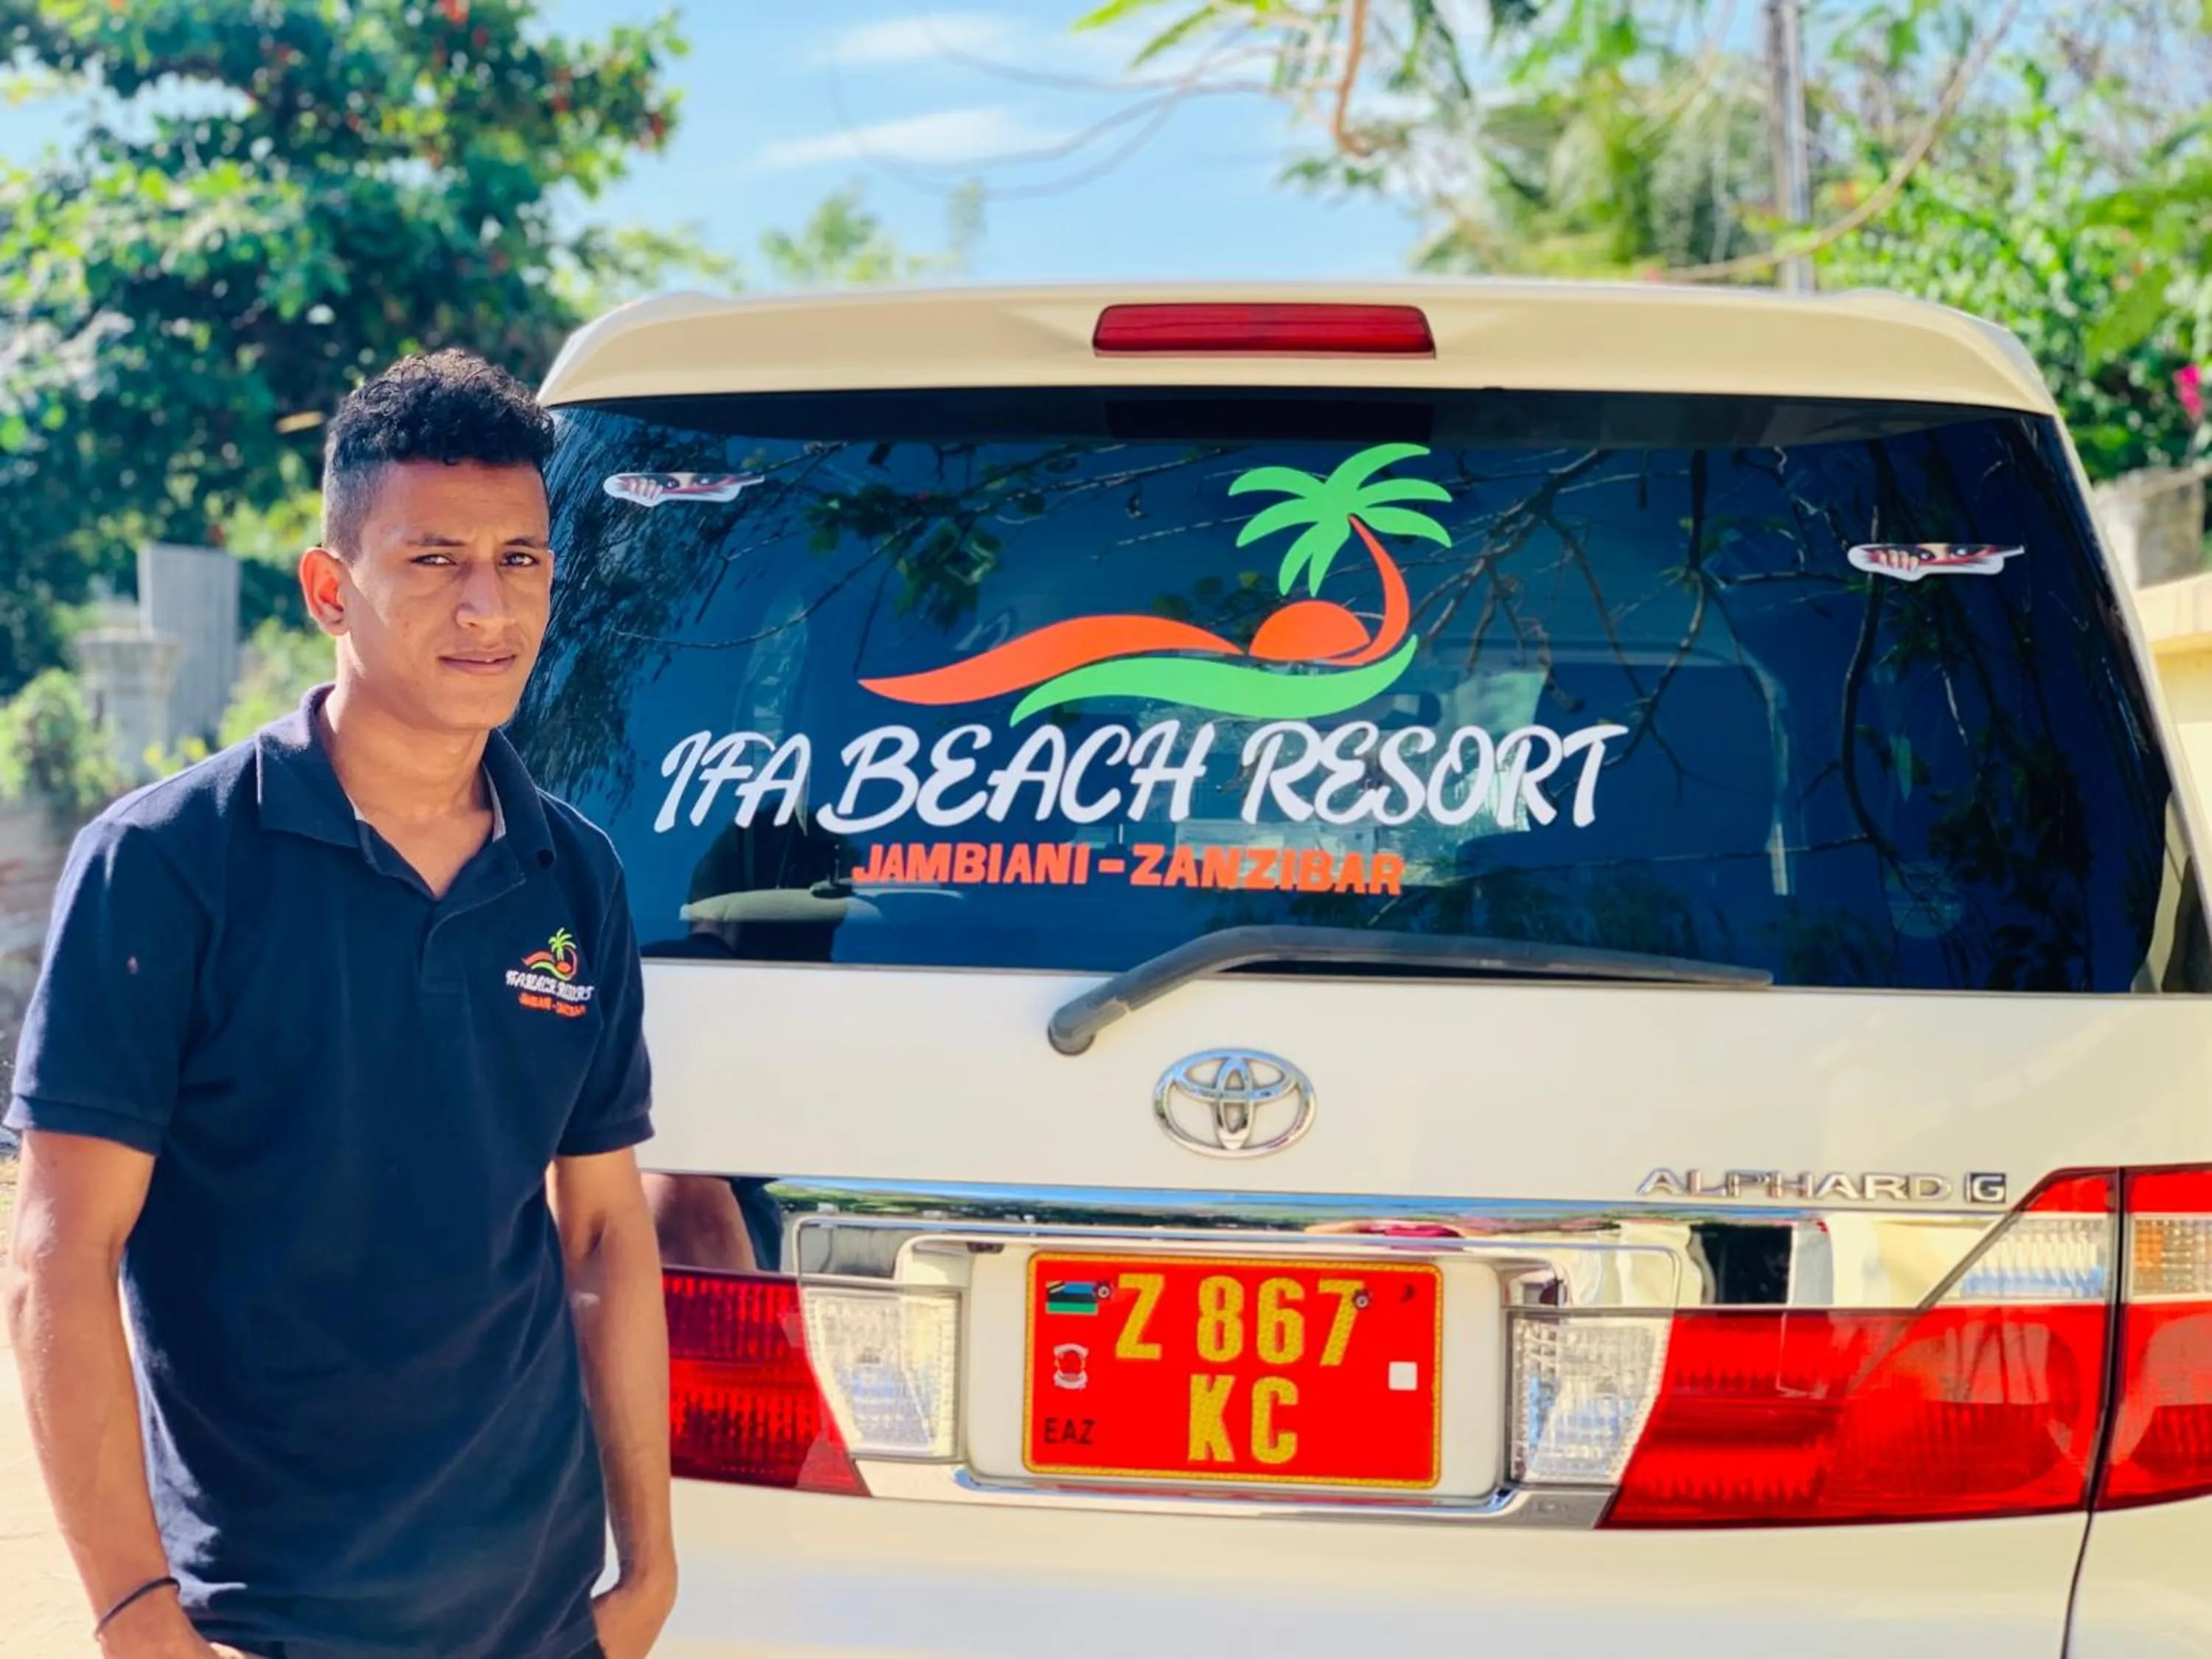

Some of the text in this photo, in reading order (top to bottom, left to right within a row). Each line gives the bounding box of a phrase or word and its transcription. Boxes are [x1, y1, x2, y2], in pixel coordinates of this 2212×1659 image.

[653, 720, 1629, 833] IFA BEACH RESORT
[1635, 1168, 2006, 1203] ALPHARD G
[1115, 1273, 1366, 1366] Z 867
[1044, 1417, 1096, 1445] EAZ
[1188, 1374, 1298, 1464] KC
